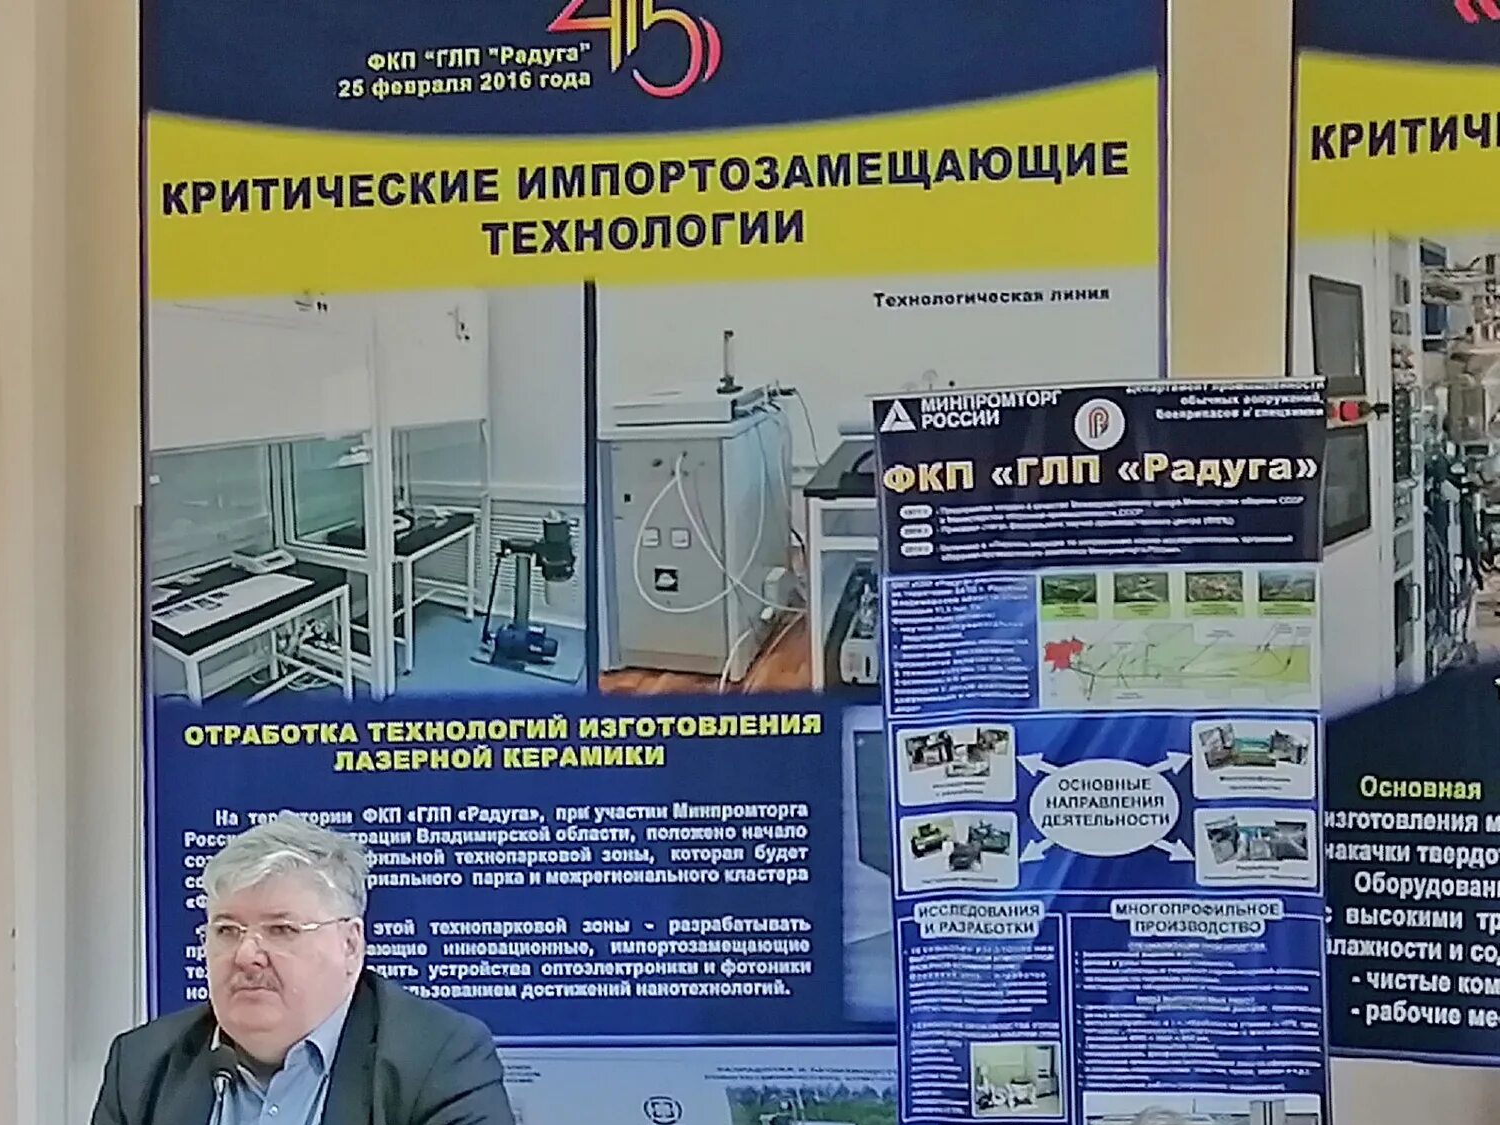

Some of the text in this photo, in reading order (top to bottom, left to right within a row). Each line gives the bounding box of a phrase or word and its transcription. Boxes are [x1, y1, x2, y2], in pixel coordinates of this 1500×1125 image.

[367, 50, 416, 72] ФКП
[338, 71, 592, 100] 25 февраля 2016 года
[1311, 111, 1500, 161] КРИТИЧ
[162, 140, 1131, 216] КРИТИЧЕСКИЕ ИМПОРТОЗАМЕЩАЮЩИЕ
[482, 209, 804, 257] ТЕХНОЛОГИИ
[873, 287, 1110, 308] Технологическая линия
[920, 390, 1063, 413] МИНПРОМТОРГ
[920, 409, 1000, 430] РОССИИ
[883, 452, 1318, 494] ФКП «ГЛП «Радуга»
[184, 713, 822, 746] ОТРАБОТКА ТЕХНОЛОГИЙ ИЗГОТОВЛЕНИЯ
[333, 744, 665, 772] ЛАЗЕРНОЙ КЕРАМИКИ
[1058, 776, 1152, 792] ОСНОВНЫЕ
[1360, 775, 1482, 800] Основная
[1045, 795, 1165, 810] НАПРАВЛЕНИЯ
[215, 809, 239, 827] На
[362, 806, 402, 824] ФКП
[407, 806, 451, 823] «ГЛП
[457, 806, 546, 824] «Радуга»,
[555, 806, 590, 822] при
[594, 804, 668, 823] участии
[672, 802, 809, 822] Минпромторга
[1041, 812, 1170, 829] ДЕЯТЕЛЬНОСТИ
[1324, 811, 1479, 833] изготовления
[416, 825, 551, 847] Владимирской
[555, 825, 636, 843] области,
[646, 827, 736, 842] положено
[742, 824, 808, 841] начало
[454, 846, 592, 868] технопарковой
[601, 848, 655, 865] зоны,
[670, 846, 745, 864] которая
[754, 843, 809, 864] будет
[1416, 845, 1500, 870] твердо
[473, 869, 525, 888] парка
[529, 870, 541, 885] и
[545, 866, 720, 888] межрегионального
[723, 866, 809, 886] кластера
[1354, 870, 1500, 900] Оборудован
[918, 903, 1041, 920] ИССЛЕДОВАНИЯ
[1115, 902, 1280, 917] МНОГОПРОФИЛЬНОЕ
[1346, 907, 1464, 930] высокими
[373, 918, 415, 935] этой
[429, 917, 568, 938] технопарковой
[582, 919, 631, 934] зоны
[668, 915, 812, 936] разрабатывать
[924, 920, 1036, 936] И РАЗРАБОТКИ
[1135, 920, 1262, 934] ПРОИЗВОДСТВО
[443, 940, 595, 958] инновационные,
[610, 938, 811, 958] импортозамещающие
[1449, 942, 1463, 961] и
[428, 959, 531, 981] устройства
[541, 960, 699, 979] оптоэлектроники
[704, 960, 716, 974] и
[720, 958, 812, 978] фотоники
[520, 979, 632, 1000] достижений
[636, 979, 792, 997] нанотехнологий.
[1366, 971, 1452, 993] чистые
[1365, 1000, 1462, 1026] рабочие
